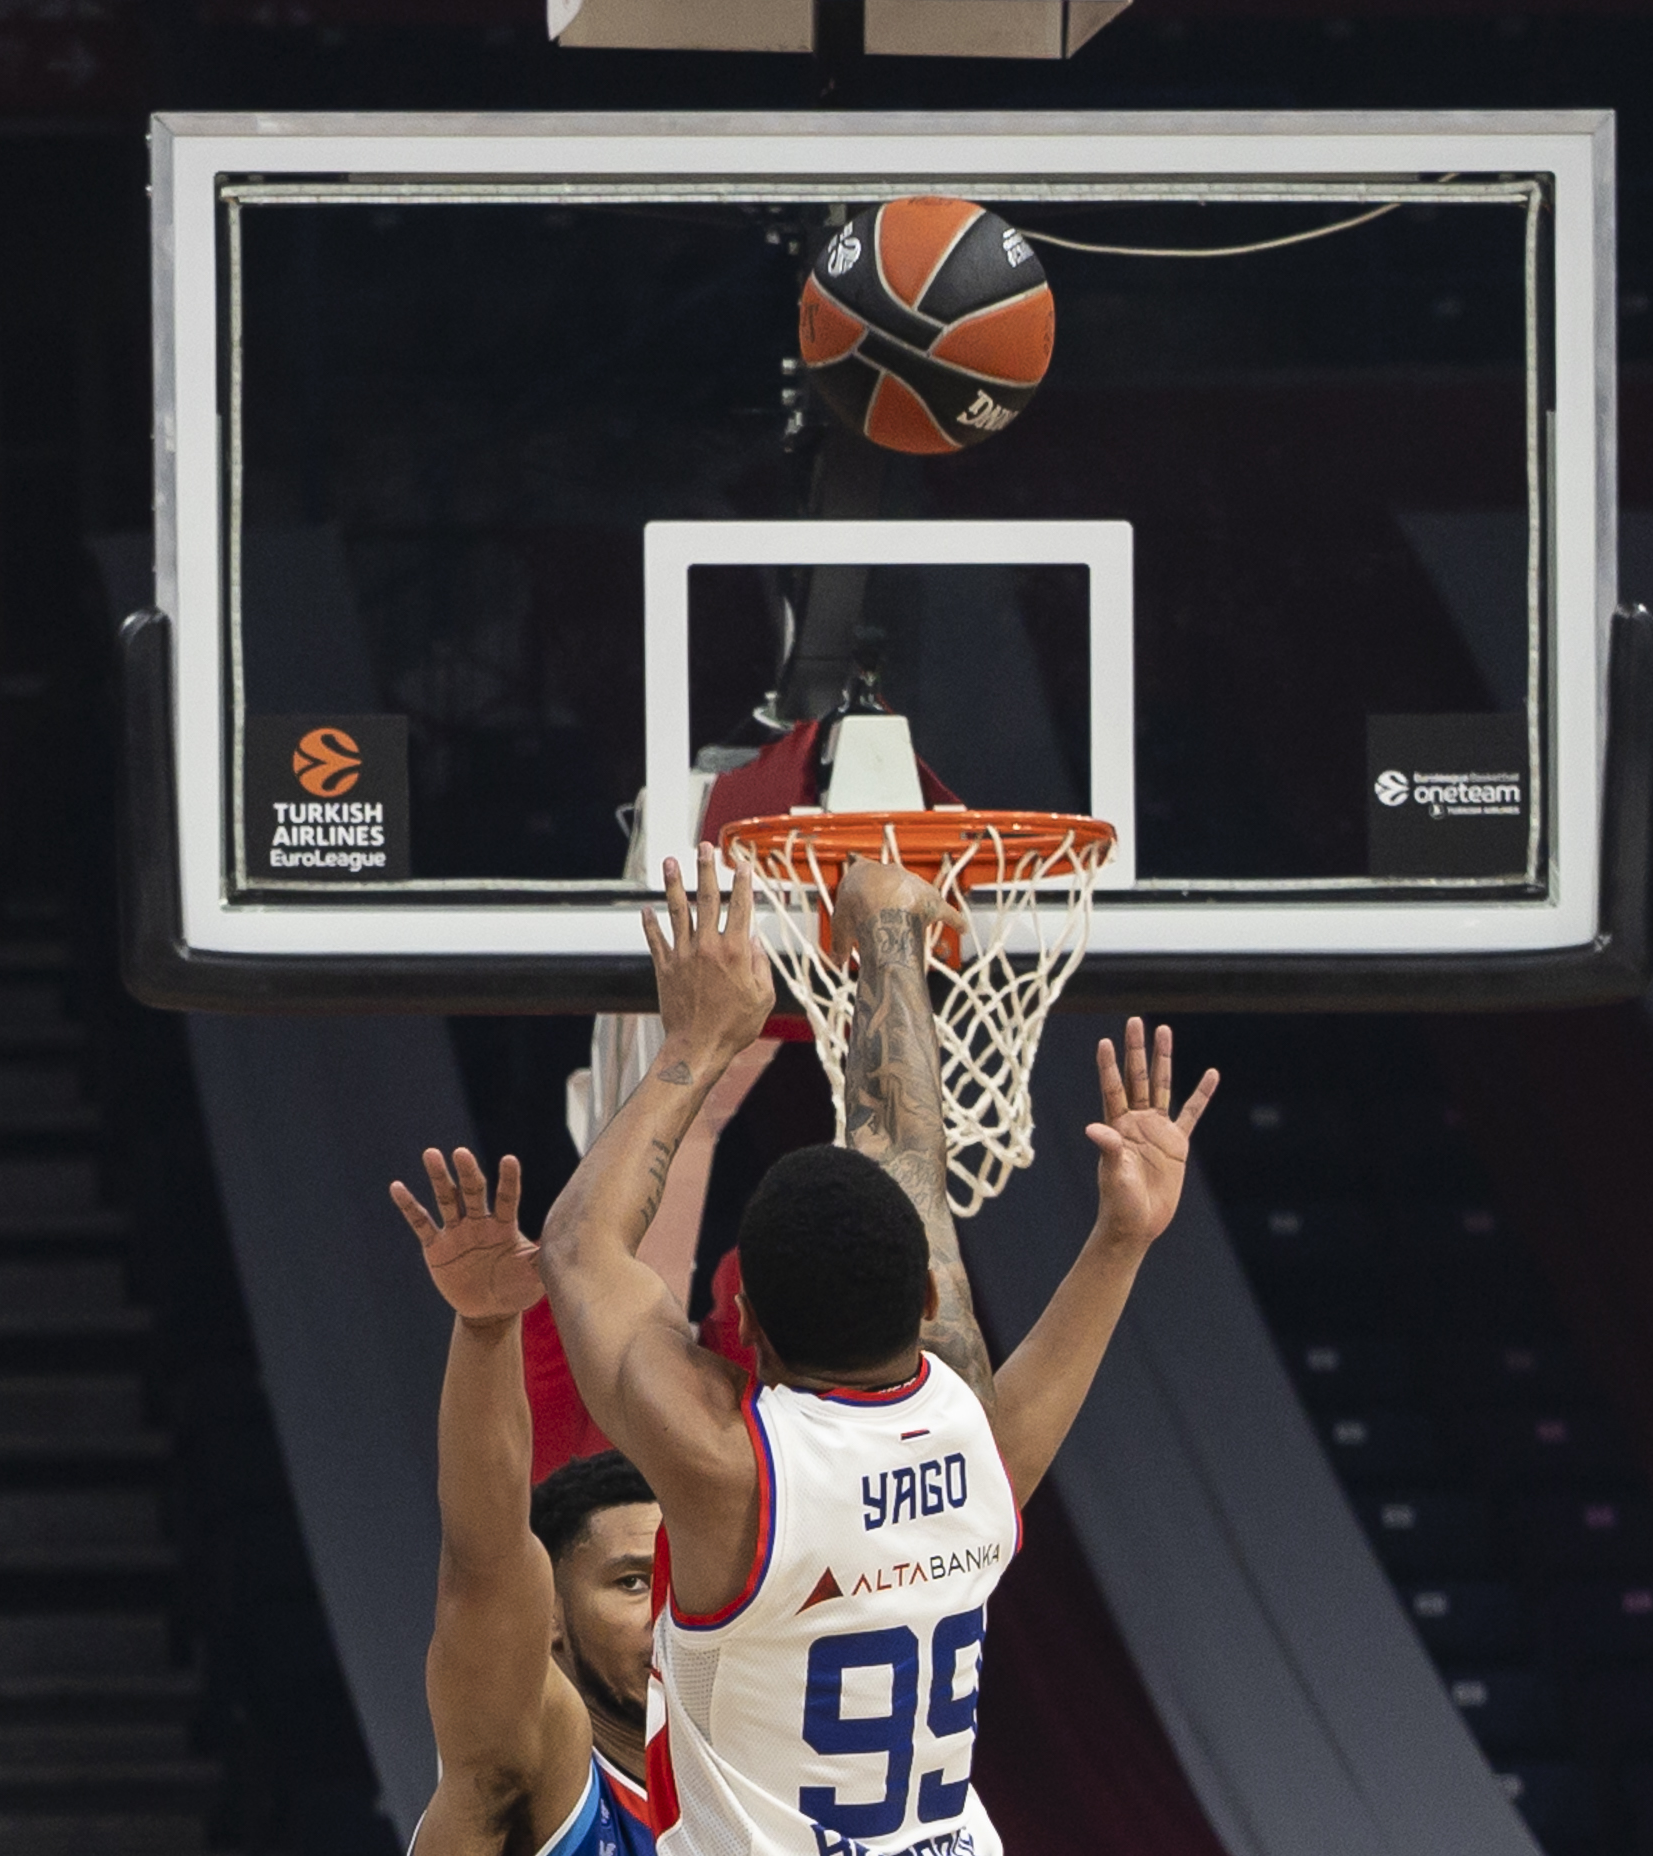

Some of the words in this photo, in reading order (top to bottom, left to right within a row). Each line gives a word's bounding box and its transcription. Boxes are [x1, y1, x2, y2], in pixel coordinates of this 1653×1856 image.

[1413, 782, 1521, 803] oneteam
[272, 802, 384, 824] TURKISH
[271, 825, 385, 847] AIRLINES
[269, 849, 387, 873] EuroLeague
[861, 1452, 968, 1531] YAGO
[799, 1604, 986, 1839] 99
